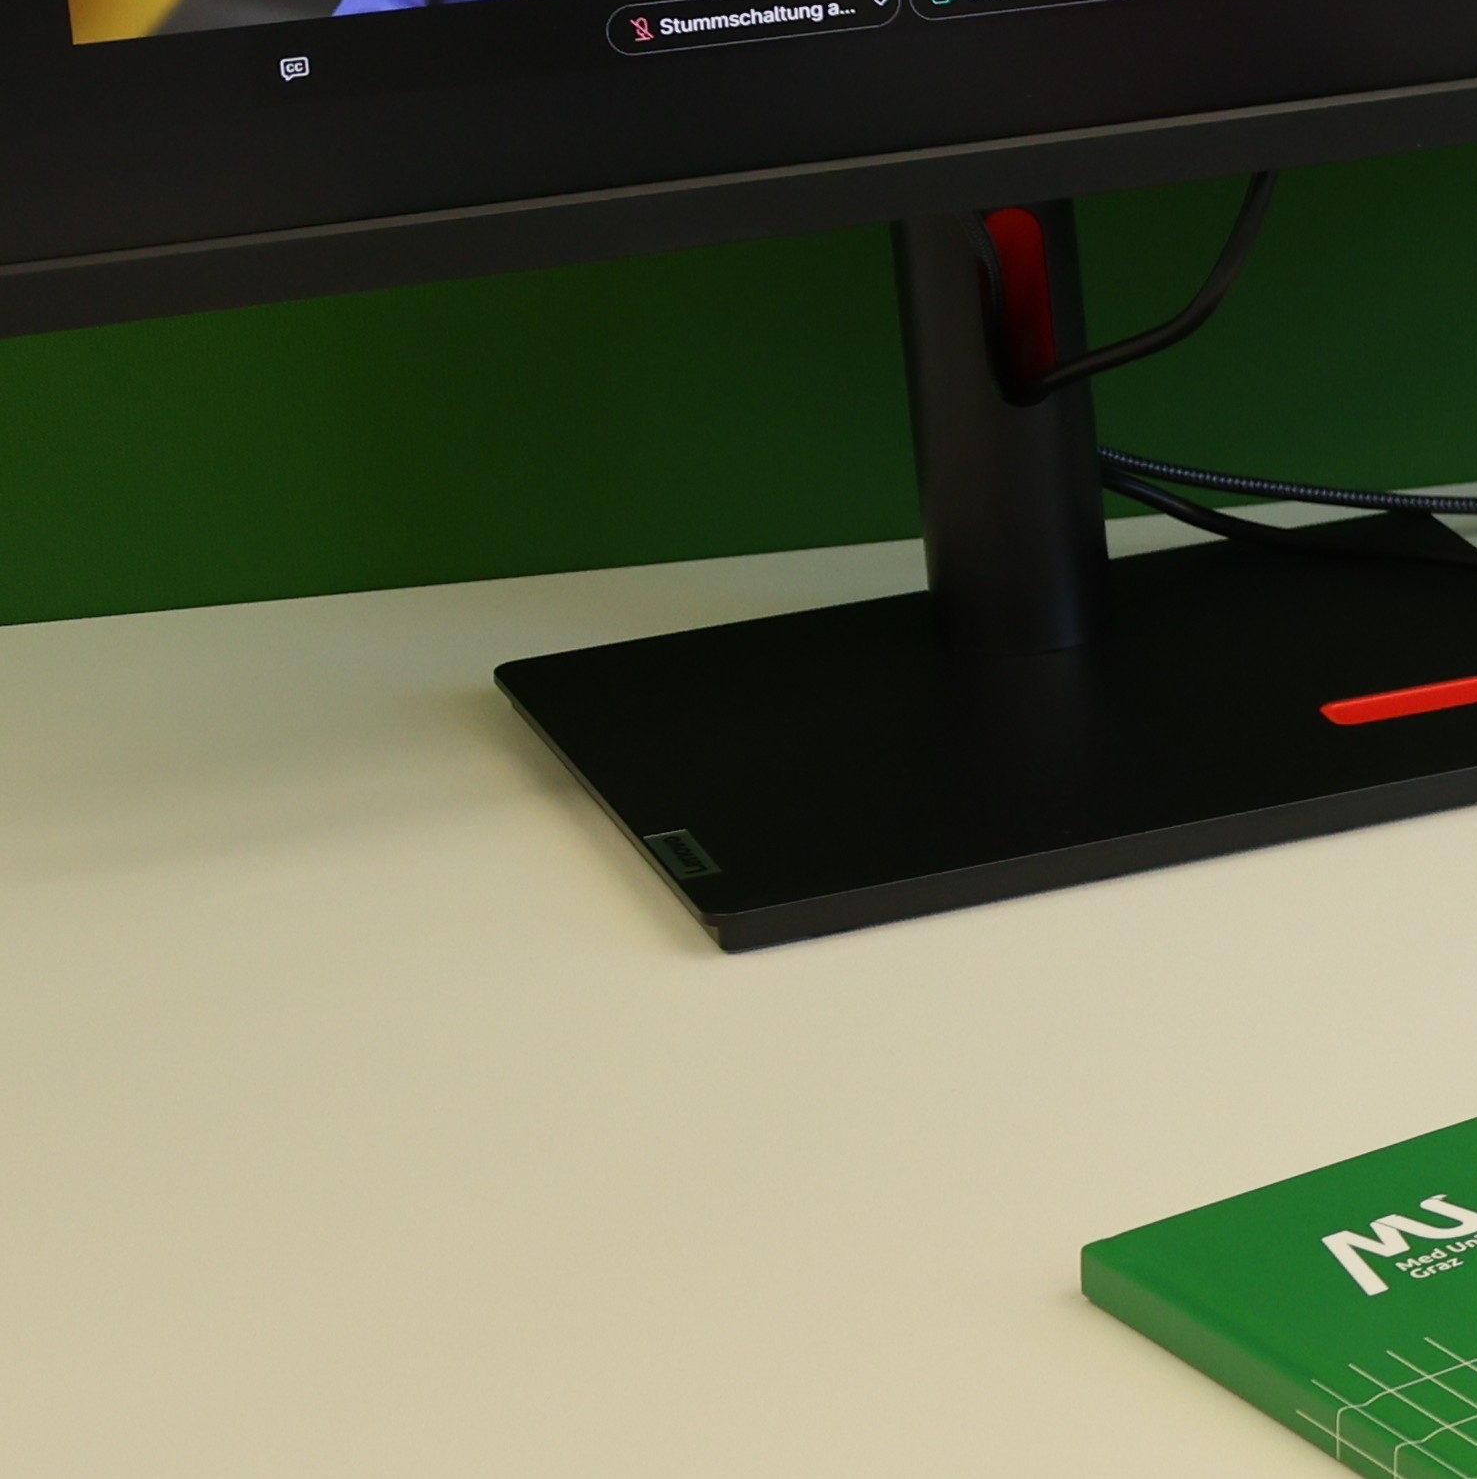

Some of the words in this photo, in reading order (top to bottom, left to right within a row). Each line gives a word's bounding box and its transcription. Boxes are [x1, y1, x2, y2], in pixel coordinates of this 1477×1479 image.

[659, 0, 825, 36] Stummschaltung
[827, 2, 856, 17] a...
[1395, 1247, 1448, 1272] Med
[1409, 1256, 1464, 1279] Graz
